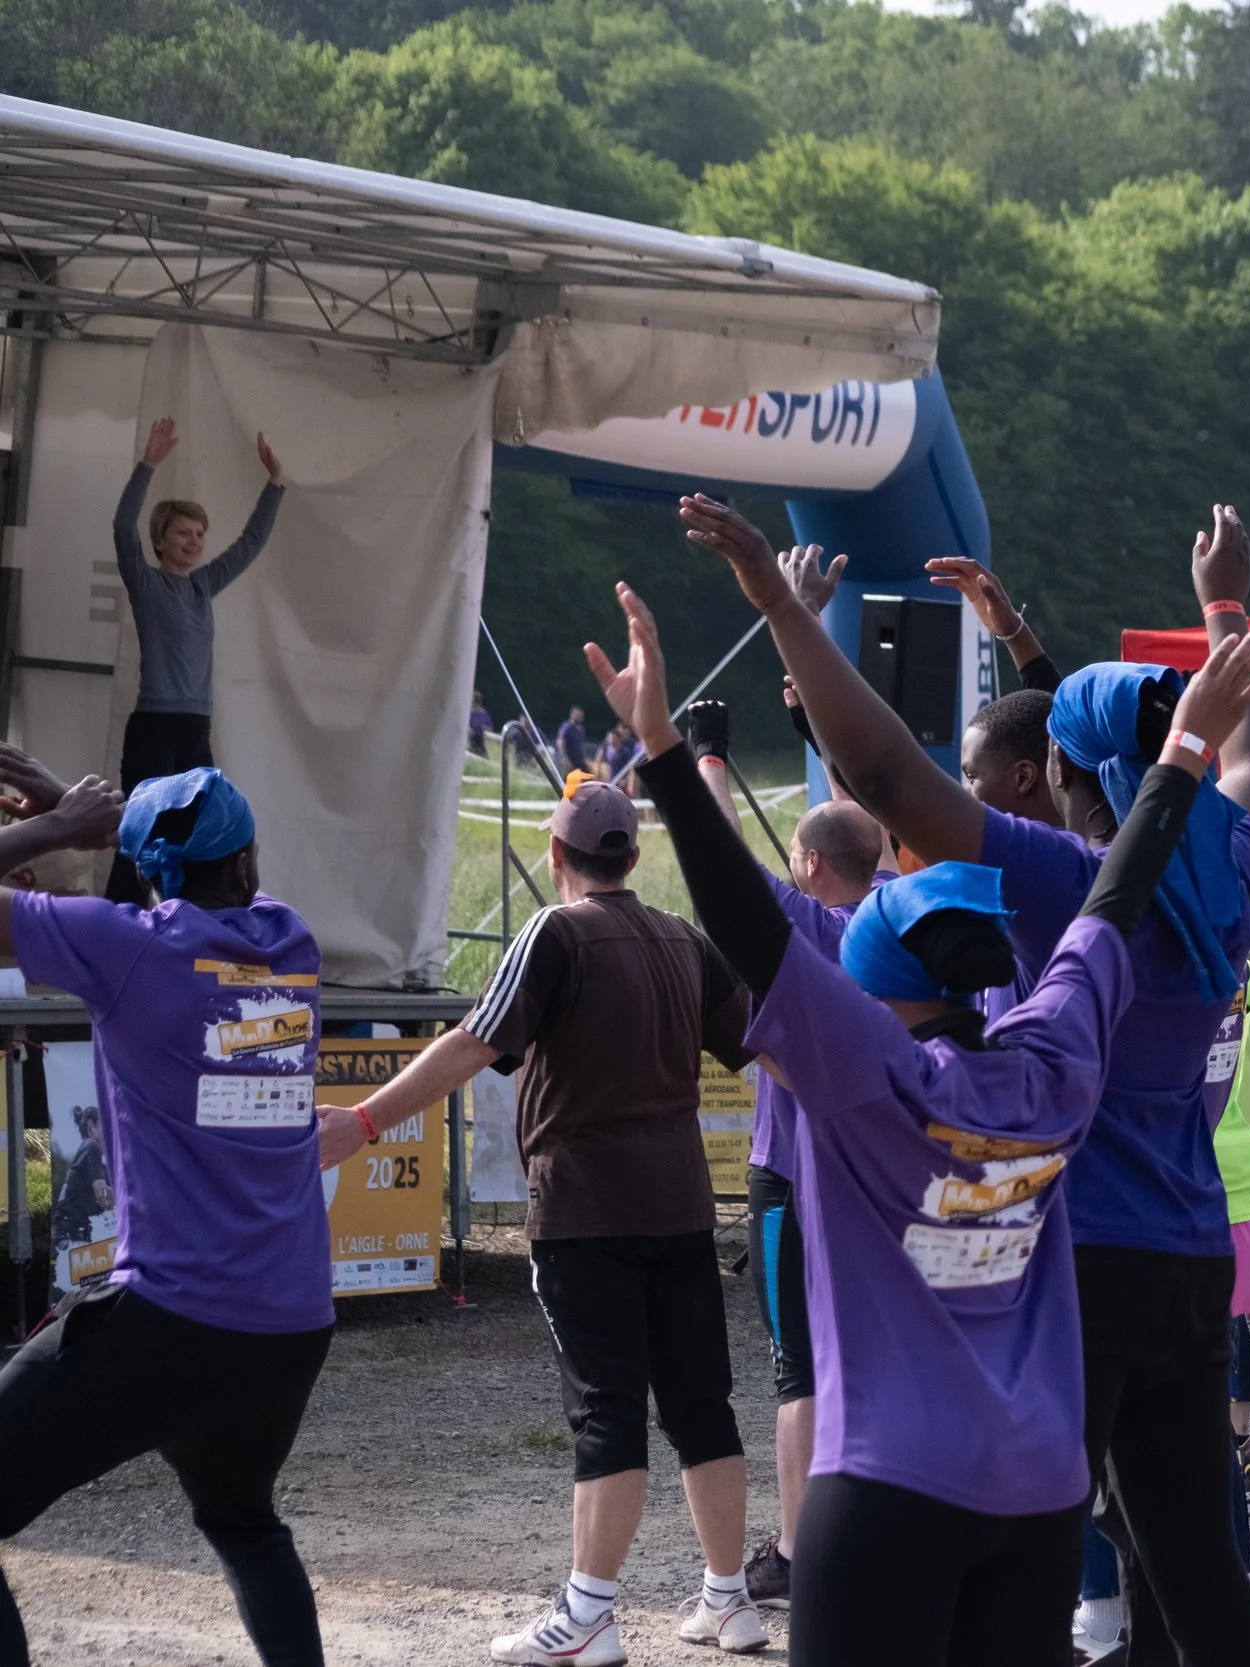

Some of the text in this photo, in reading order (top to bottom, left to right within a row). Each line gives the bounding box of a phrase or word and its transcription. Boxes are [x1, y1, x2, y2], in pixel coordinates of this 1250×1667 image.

[366, 1156, 420, 1190] 2025
[339, 1235, 385, 1254] L'AIGLE
[396, 1232, 429, 1250] ORNE
